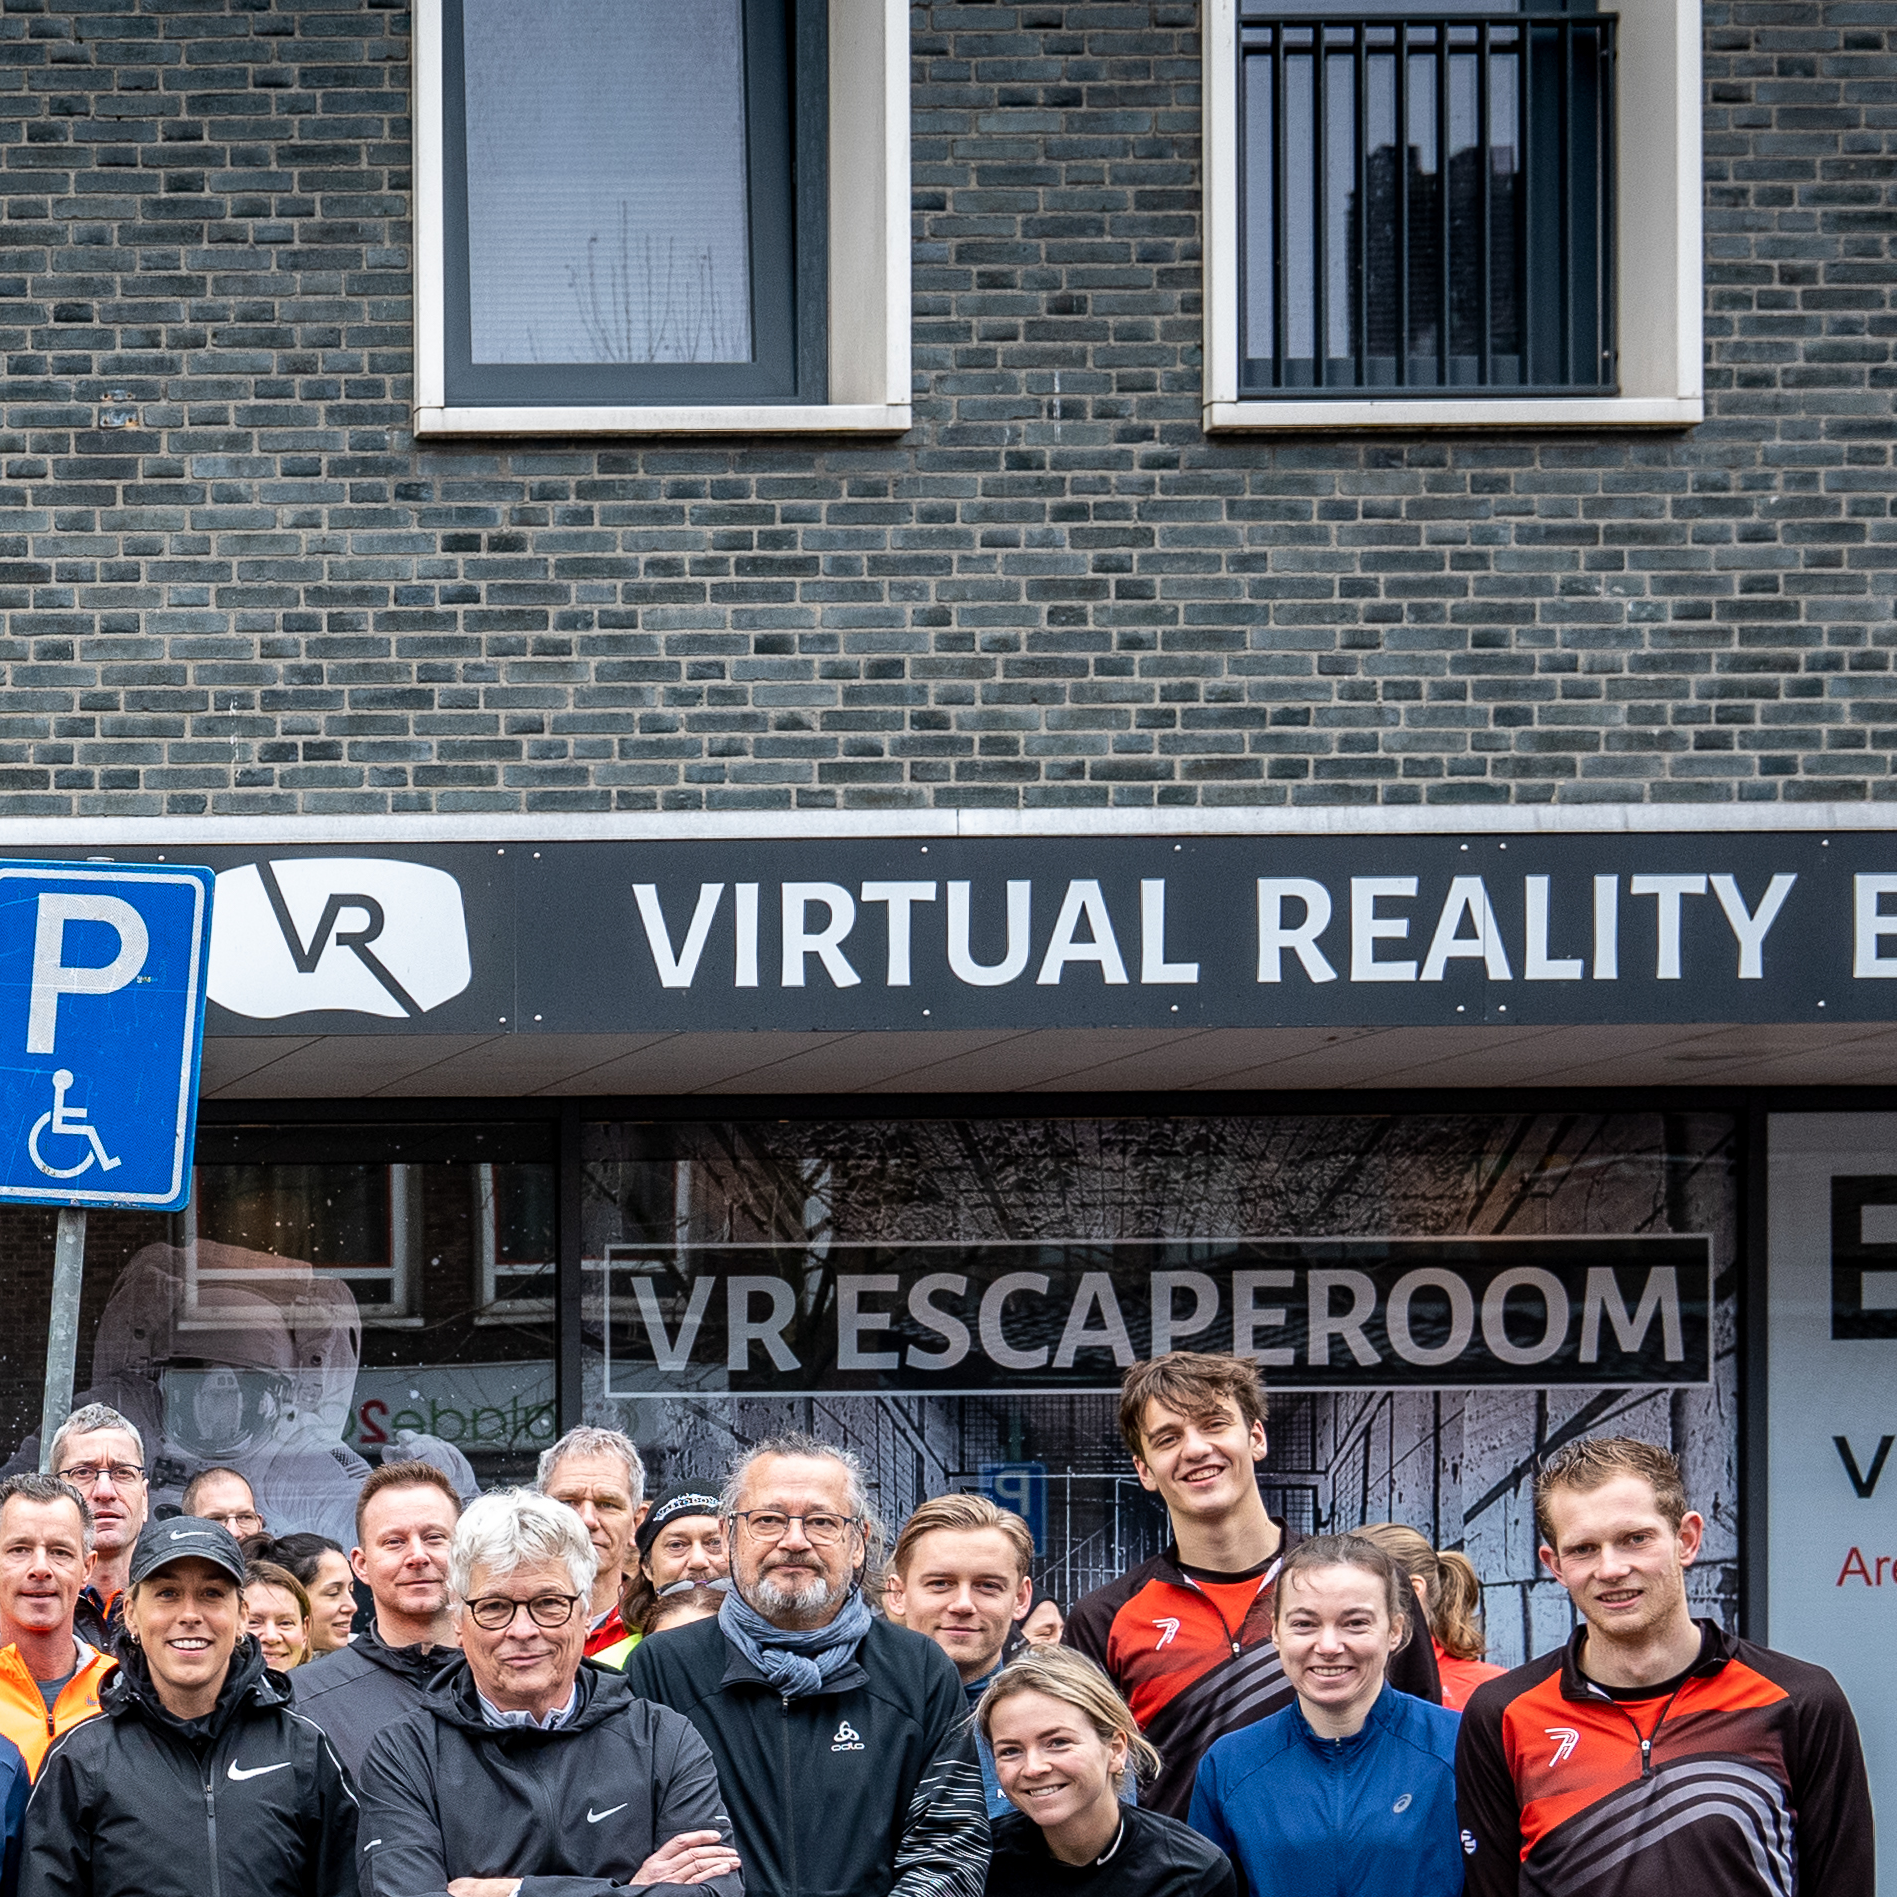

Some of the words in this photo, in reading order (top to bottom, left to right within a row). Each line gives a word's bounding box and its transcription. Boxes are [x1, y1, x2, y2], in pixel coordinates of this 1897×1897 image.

[24, 891, 150, 1054] P
[632, 877, 1199, 989] VIRTUAL
[1257, 872, 1798, 985] REALITY
[632, 1275, 801, 1373] VR
[836, 1265, 1686, 1371] ESCAPEROOM
[830, 1742, 865, 1752] odlo
